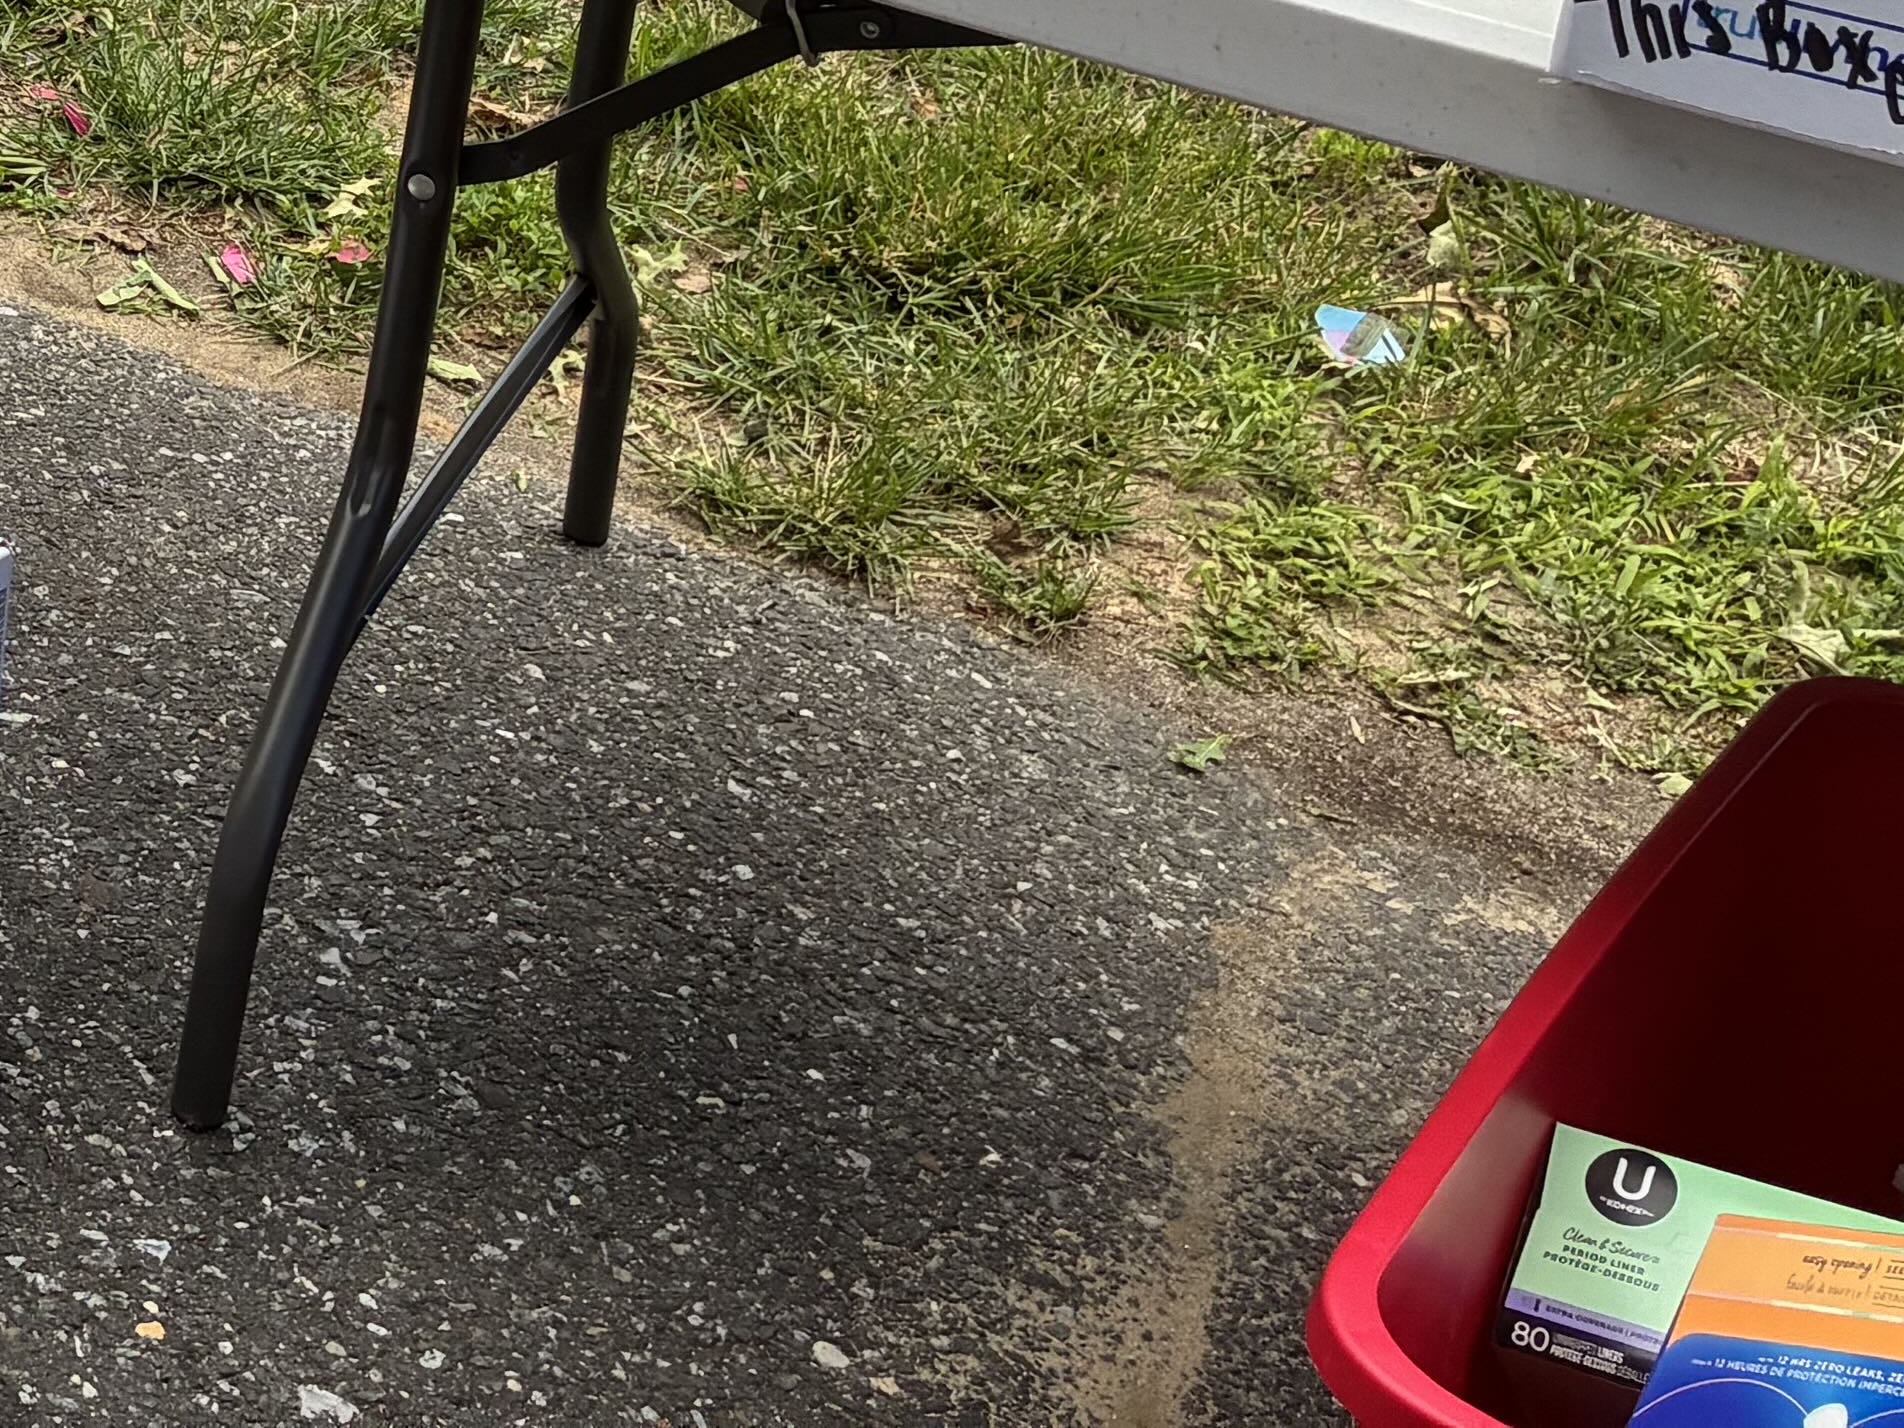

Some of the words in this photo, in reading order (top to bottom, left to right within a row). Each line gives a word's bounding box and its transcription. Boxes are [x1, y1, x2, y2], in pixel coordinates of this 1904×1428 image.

[1612, 1156, 1657, 1201] U
[1563, 1227, 1598, 1248] Clean
[1562, 1244, 1607, 1265] PERIOD
[1610, 1258, 1646, 1276] LINER
[1511, 1320, 1550, 1353] 80
[1726, 1360, 1768, 1375] HEURES
[1768, 1365, 1785, 1378] DE
[1813, 1360, 1845, 1375] ZERO
